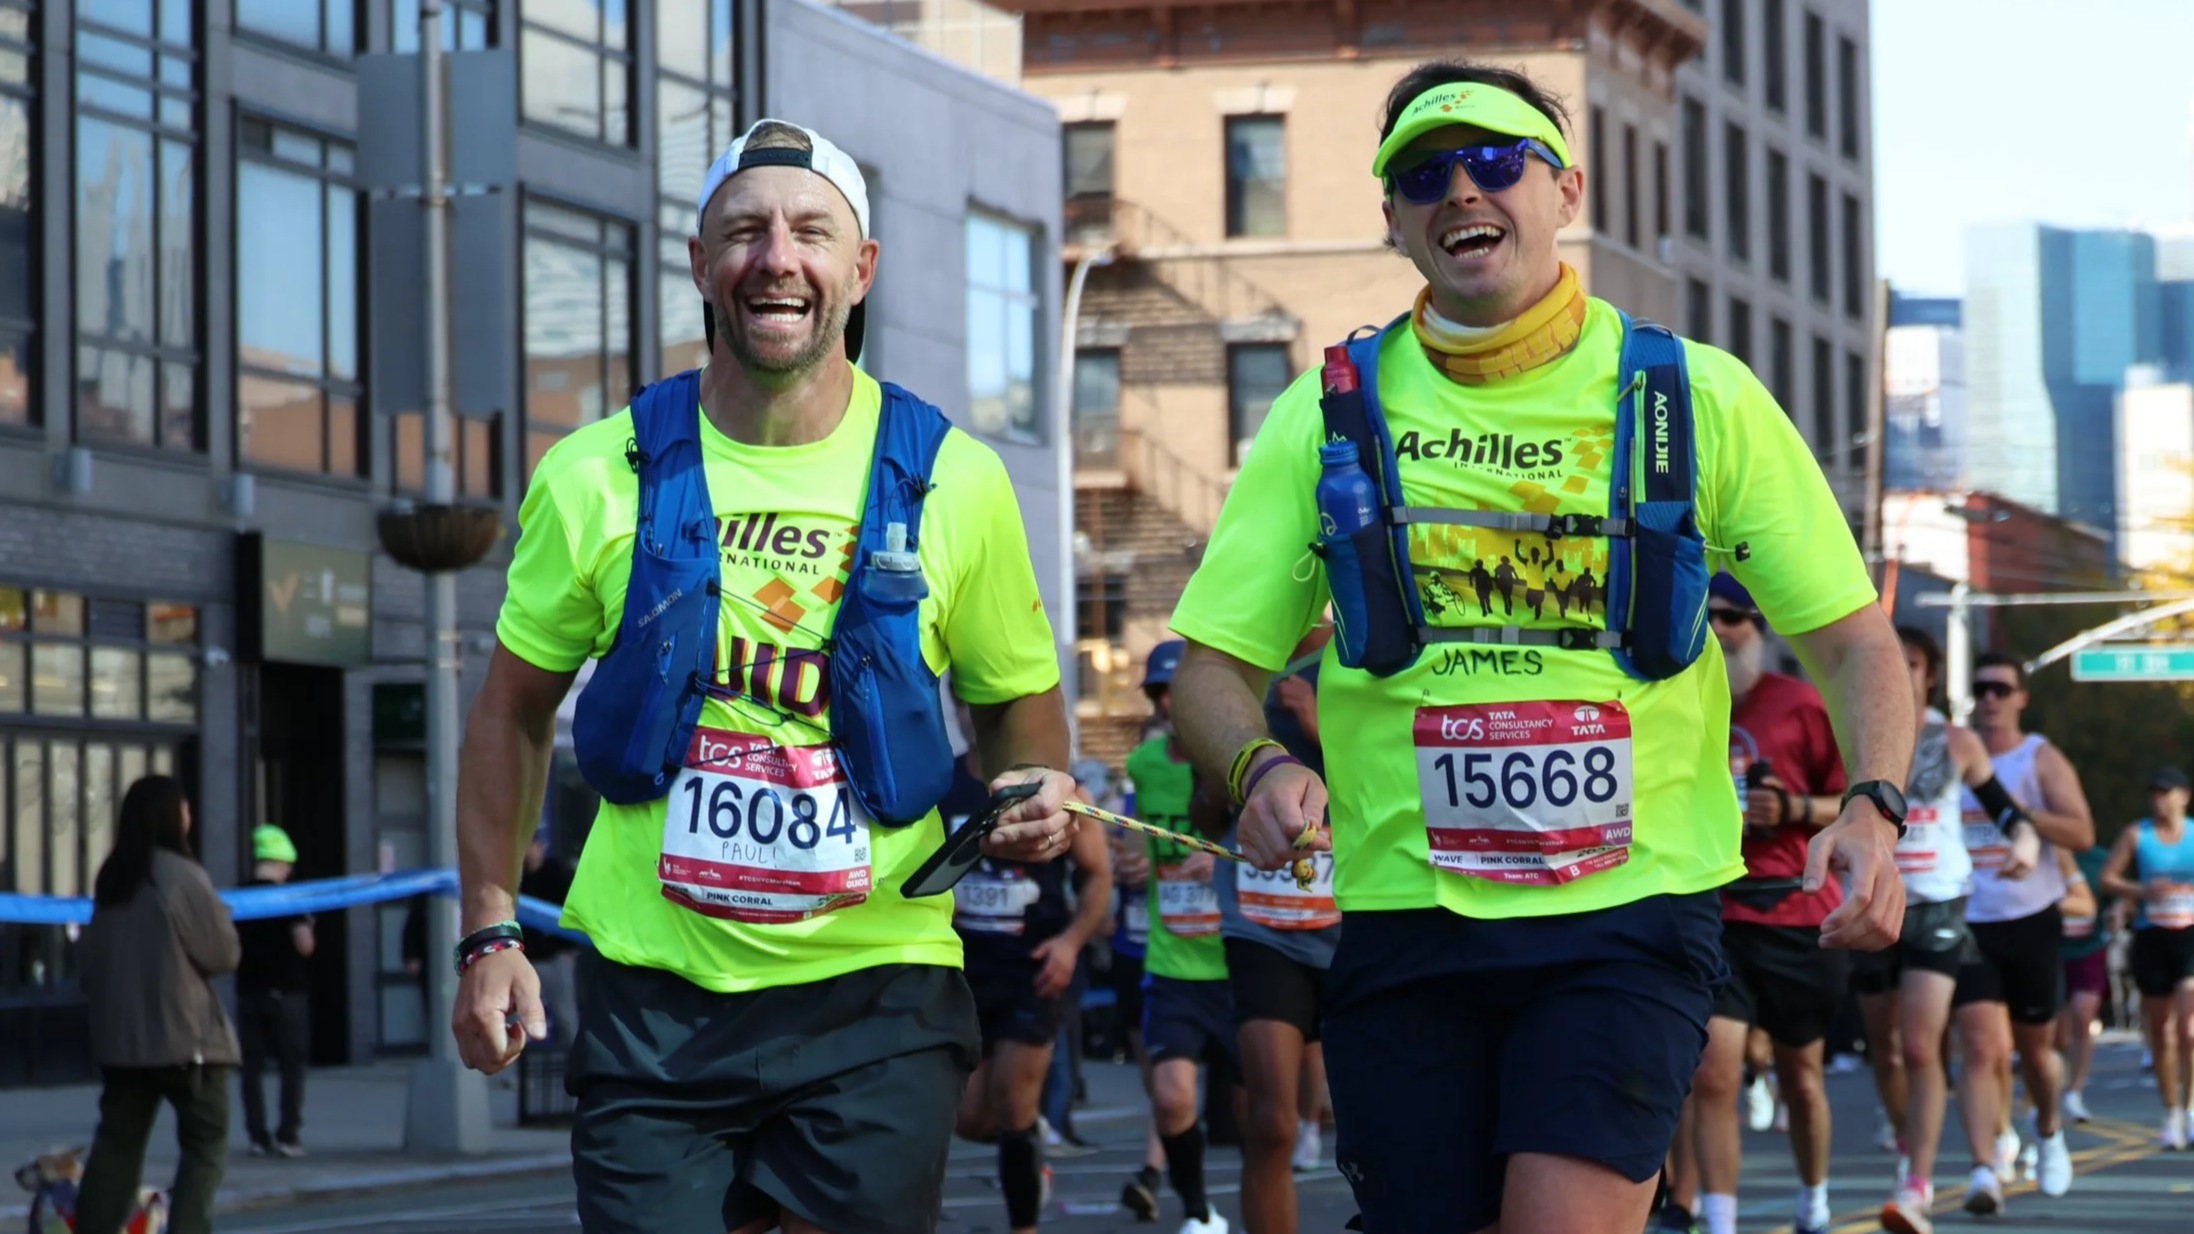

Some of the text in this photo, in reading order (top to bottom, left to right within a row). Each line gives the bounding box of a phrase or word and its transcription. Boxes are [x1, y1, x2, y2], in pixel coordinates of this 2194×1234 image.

[1412, 93, 1456, 117] Achilles
[1654, 390, 1669, 474] AONIJIE
[1396, 428, 1563, 470] Achilles
[713, 512, 831, 560] illes
[719, 551, 820, 576] NATIONAL
[1431, 648, 1543, 676] JAMES
[708, 635, 830, 718] UID
[1488, 710, 1516, 721] TATA
[1441, 714, 1484, 741] tcs
[1488, 719, 1554, 731] CONSULTANCY
[1571, 723, 1605, 736] TATA
[1489, 730, 1531, 741] SERVICES
[699, 734, 743, 769] tcs
[744, 762, 786, 778] SERVICES
[1434, 746, 1618, 809] 15668
[684, 776, 857, 850] 16084
[1605, 827, 1631, 841] AWD
[1433, 855, 1464, 864] WAVE
[1480, 855, 1545, 865] PINK CORRAL
[848, 869, 867, 880] AWD
[1569, 865, 1581, 877] B
[846, 877, 869, 889] GUIDE
[707, 891, 730, 903] PINK
[732, 894, 774, 907] CORRAL
